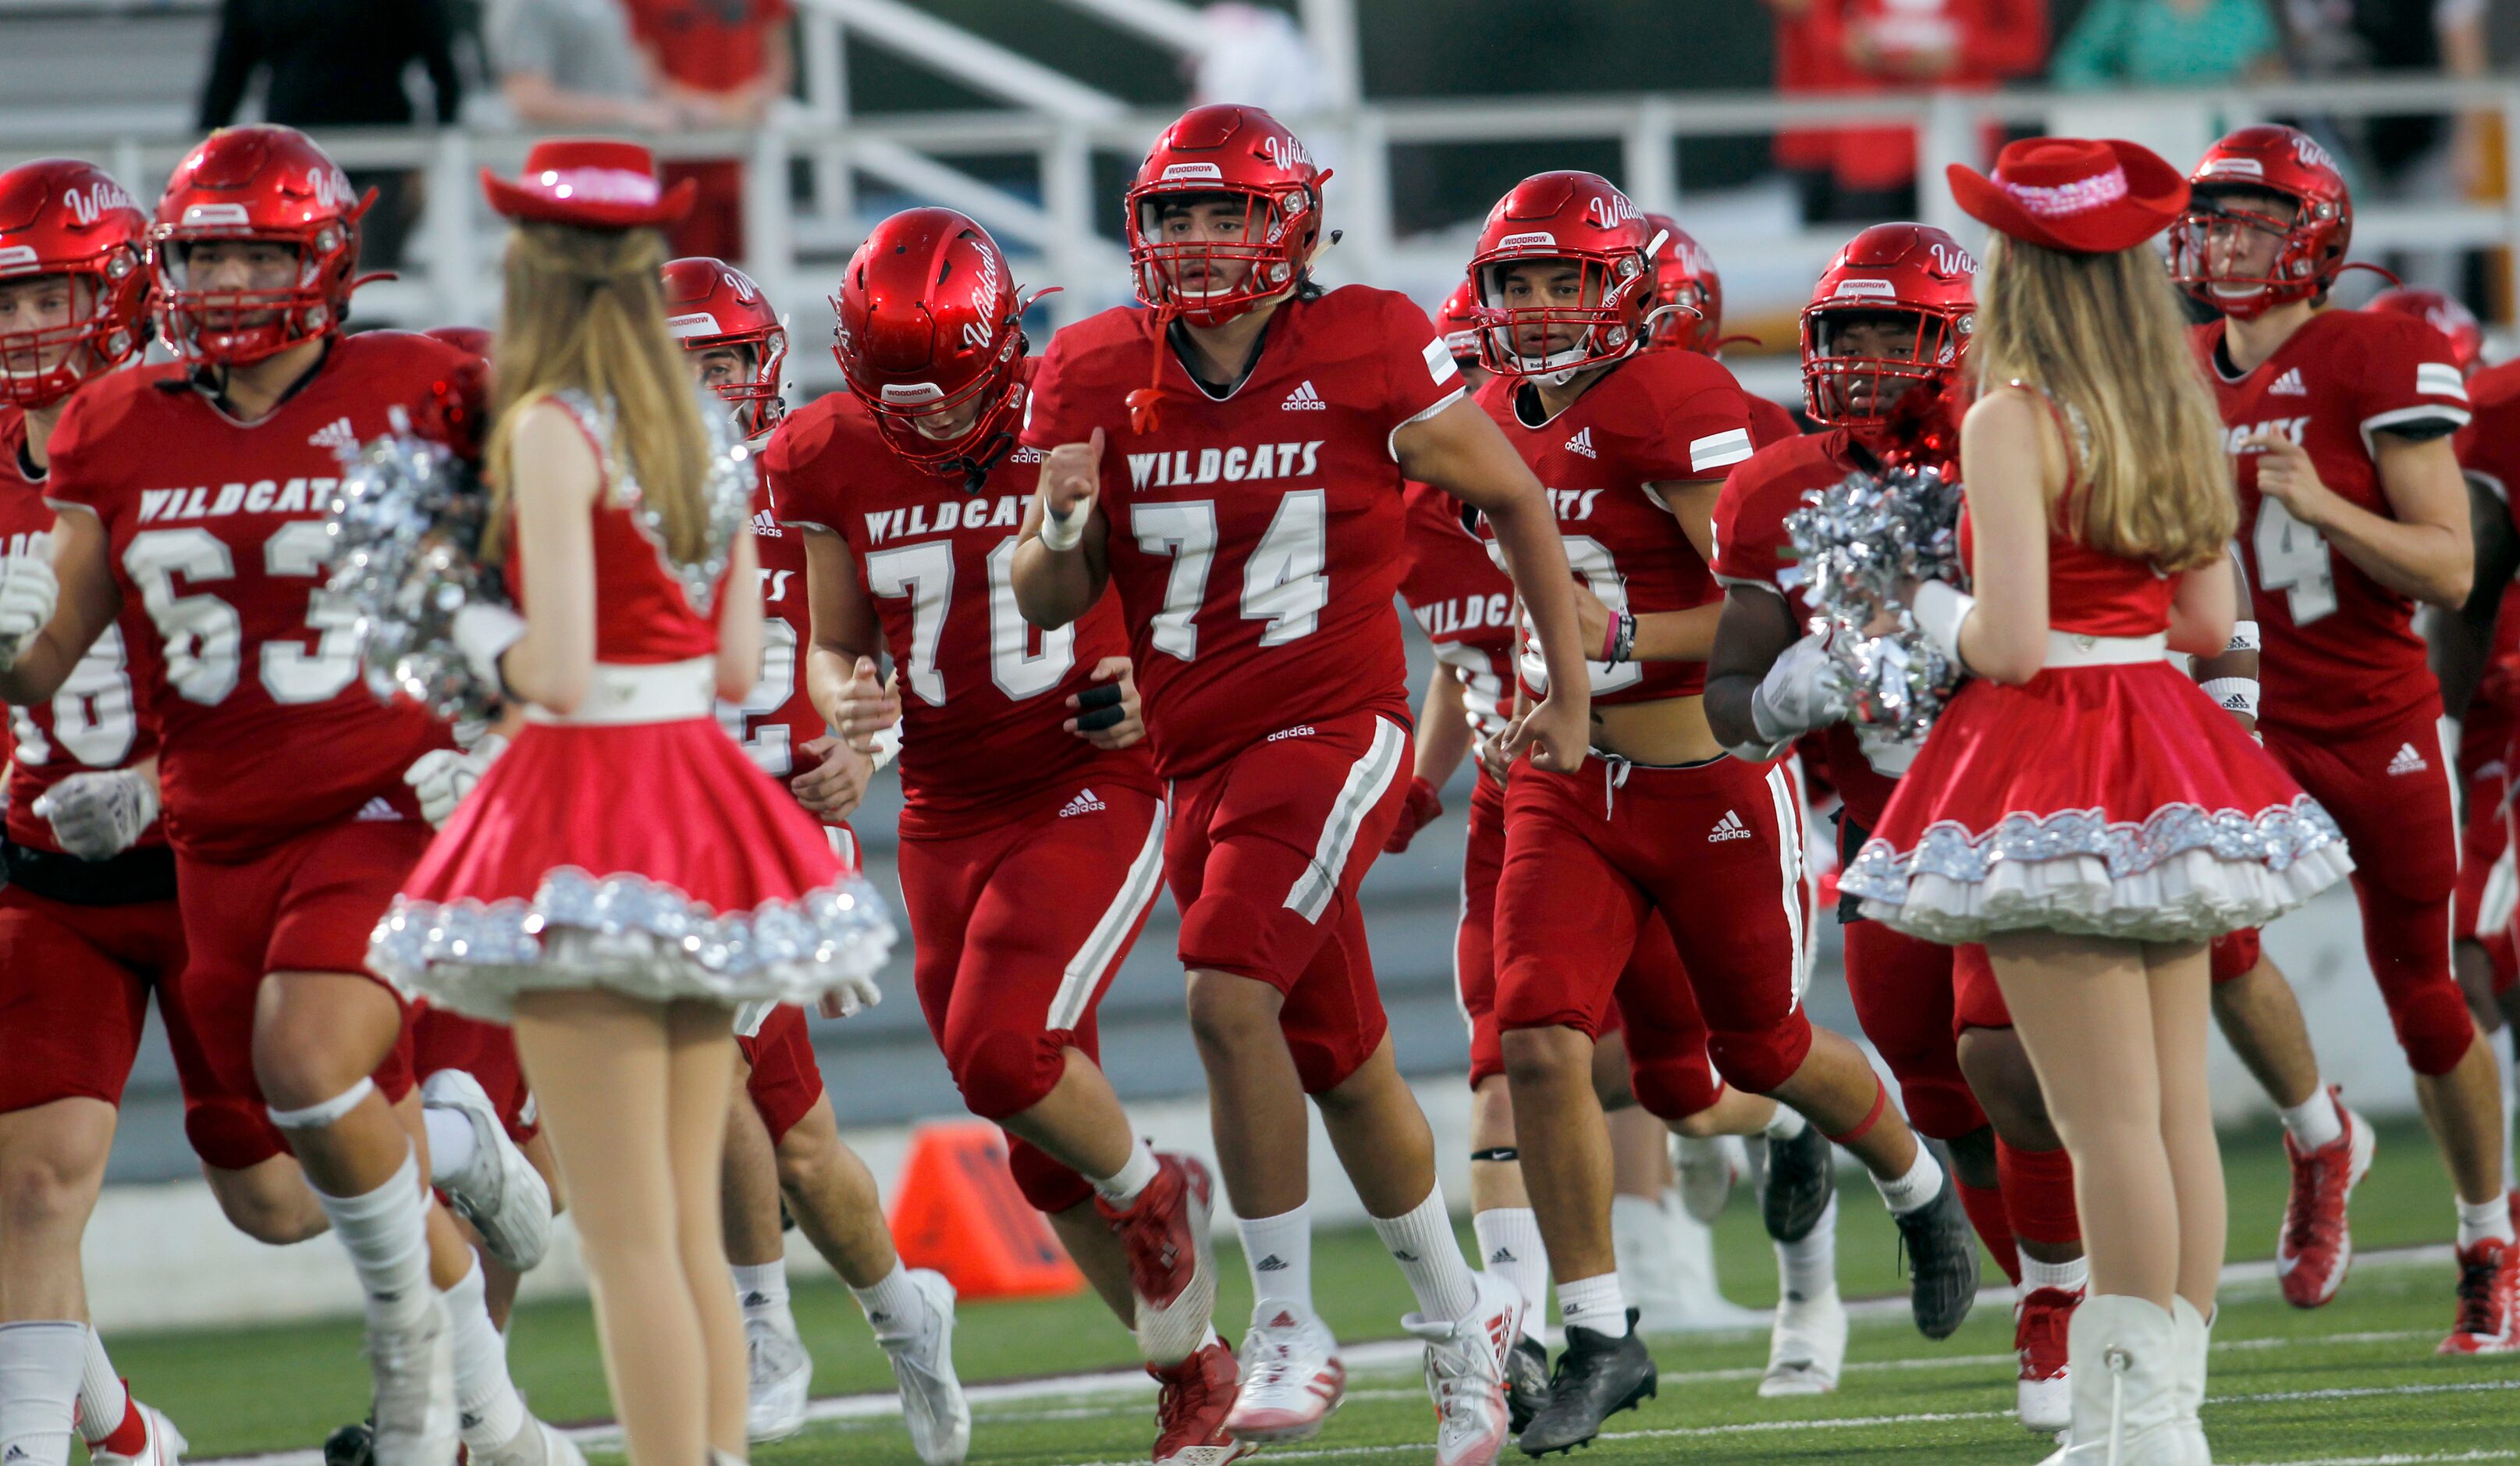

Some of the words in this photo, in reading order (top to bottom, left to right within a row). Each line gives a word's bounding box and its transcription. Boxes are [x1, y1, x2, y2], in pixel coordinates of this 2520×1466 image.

[1265, 136, 1313, 170] Wild
[1168, 165, 1213, 174] WOODROW
[1591, 195, 1643, 229] Wild
[1505, 236, 1547, 244] WOODROW
[963, 241, 997, 348] Wildcats
[887, 387, 931, 397] WOODROW
[1281, 399, 1326, 411] adidas
[1011, 452, 1041, 463] adid
[1565, 441, 1597, 459] adidas
[1127, 440, 1325, 493] WILDCATS
[137, 478, 338, 524] WILDCAT
[865, 495, 1036, 545] WILDCAT
[1130, 489, 1328, 662] 74
[122, 521, 361, 706] 63
[1413, 593, 1516, 635] WILDC
[2227, 641, 2250, 649] didas
[1267, 727, 1315, 742] adidas
[1059, 801, 1105, 817] adidas
[1708, 828, 1750, 842] adidas
